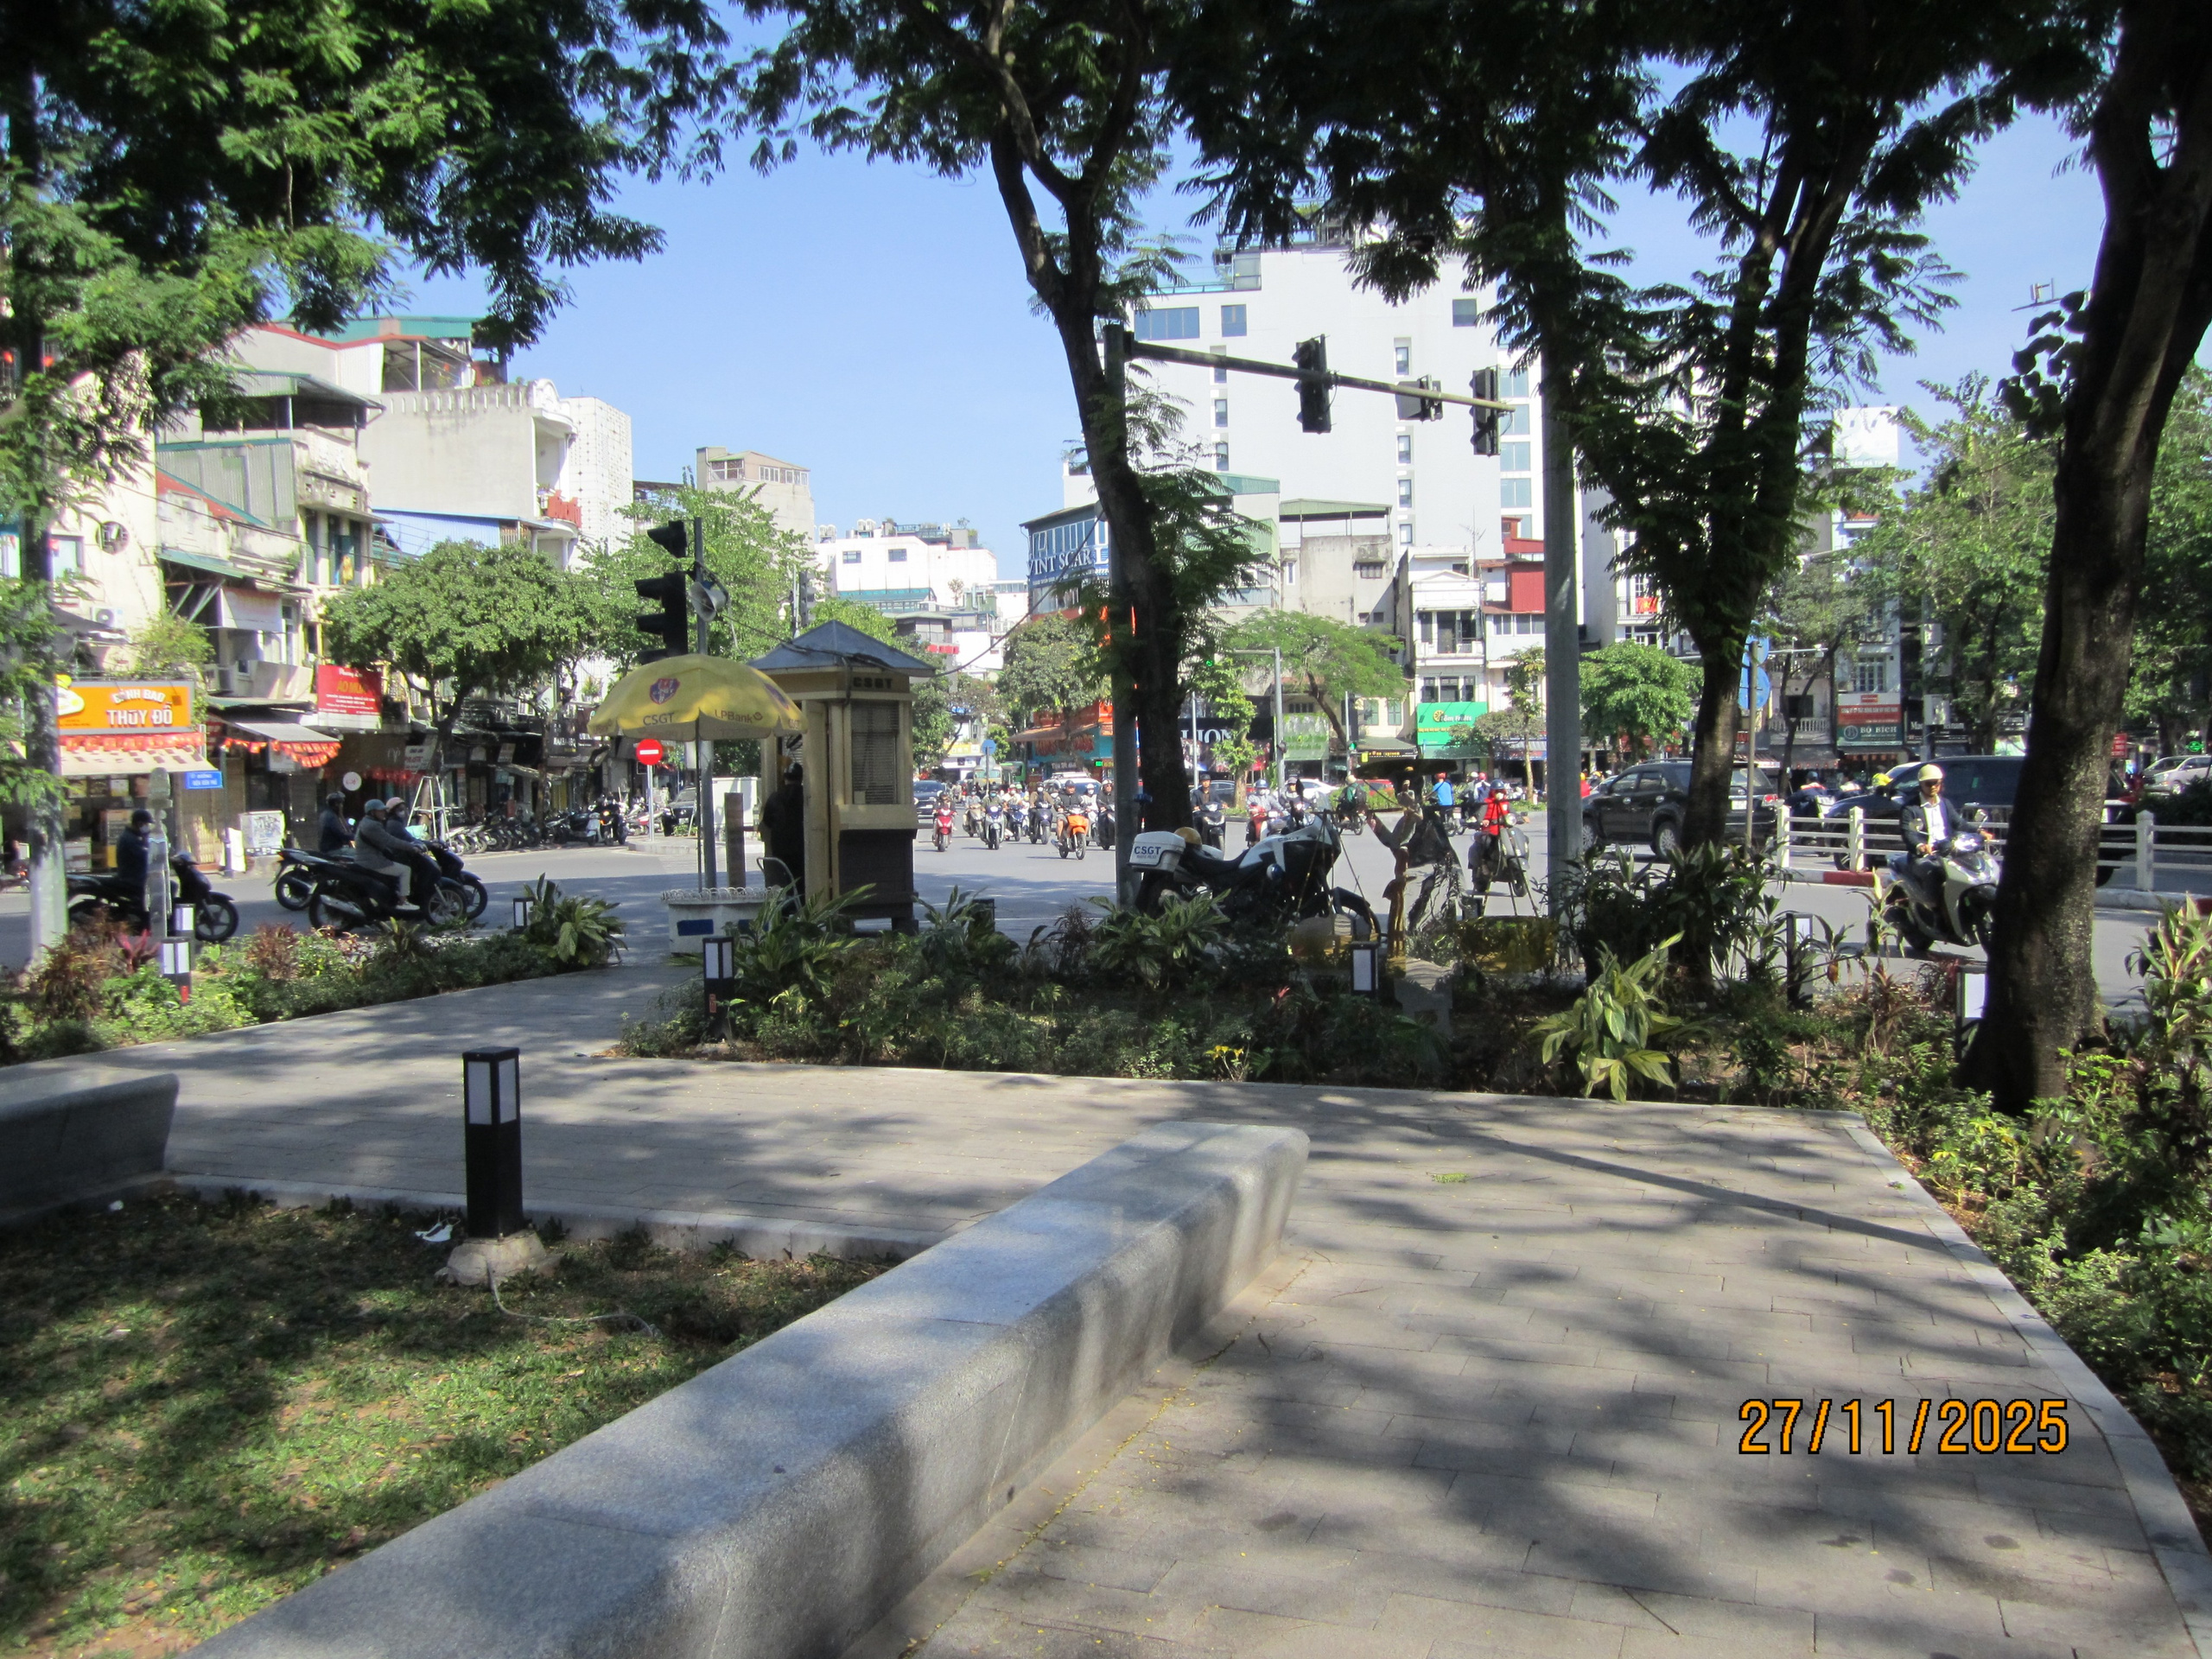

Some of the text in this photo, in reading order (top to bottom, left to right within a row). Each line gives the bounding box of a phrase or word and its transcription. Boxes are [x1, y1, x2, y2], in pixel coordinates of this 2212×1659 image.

[853, 677, 893, 689] CSGT
[143, 689, 166, 702] BAO
[643, 713, 674, 726] CSGT
[715, 709, 753, 723] LPBank
